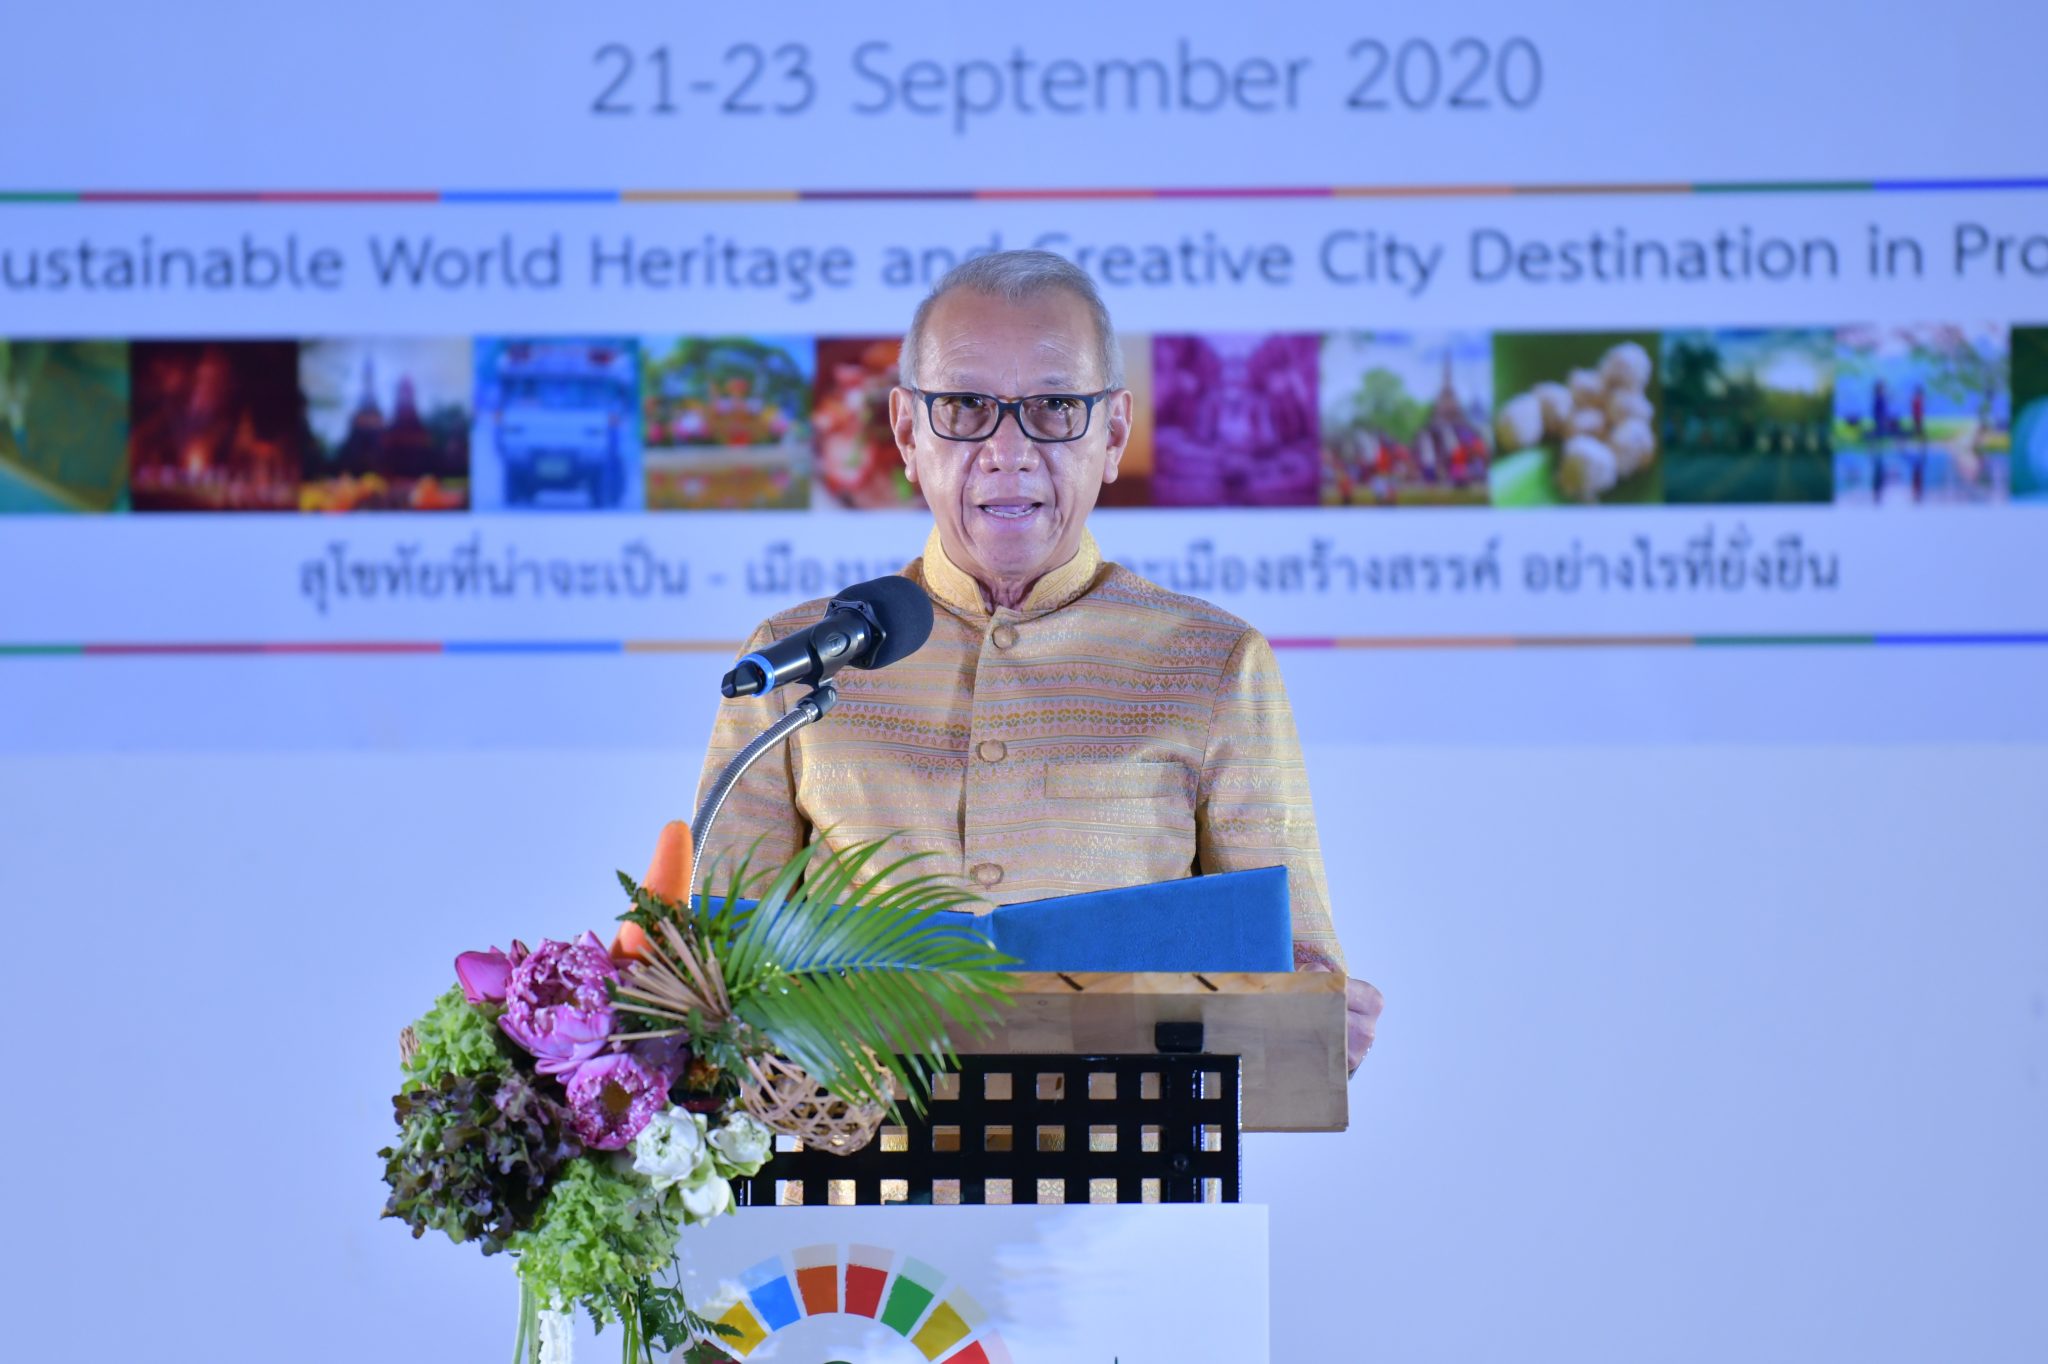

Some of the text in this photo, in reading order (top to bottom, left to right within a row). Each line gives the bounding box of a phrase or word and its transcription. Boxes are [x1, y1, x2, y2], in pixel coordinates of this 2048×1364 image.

[589, 36, 1544, 135] 21-23 September 2020
[367, 232, 563, 291] World
[589, 232, 856, 304] Heritage
[1317, 228, 1446, 299] City
[1469, 224, 1841, 285] Destination
[1867, 223, 1925, 279] in
[1954, 221, 2048, 279] Pro
